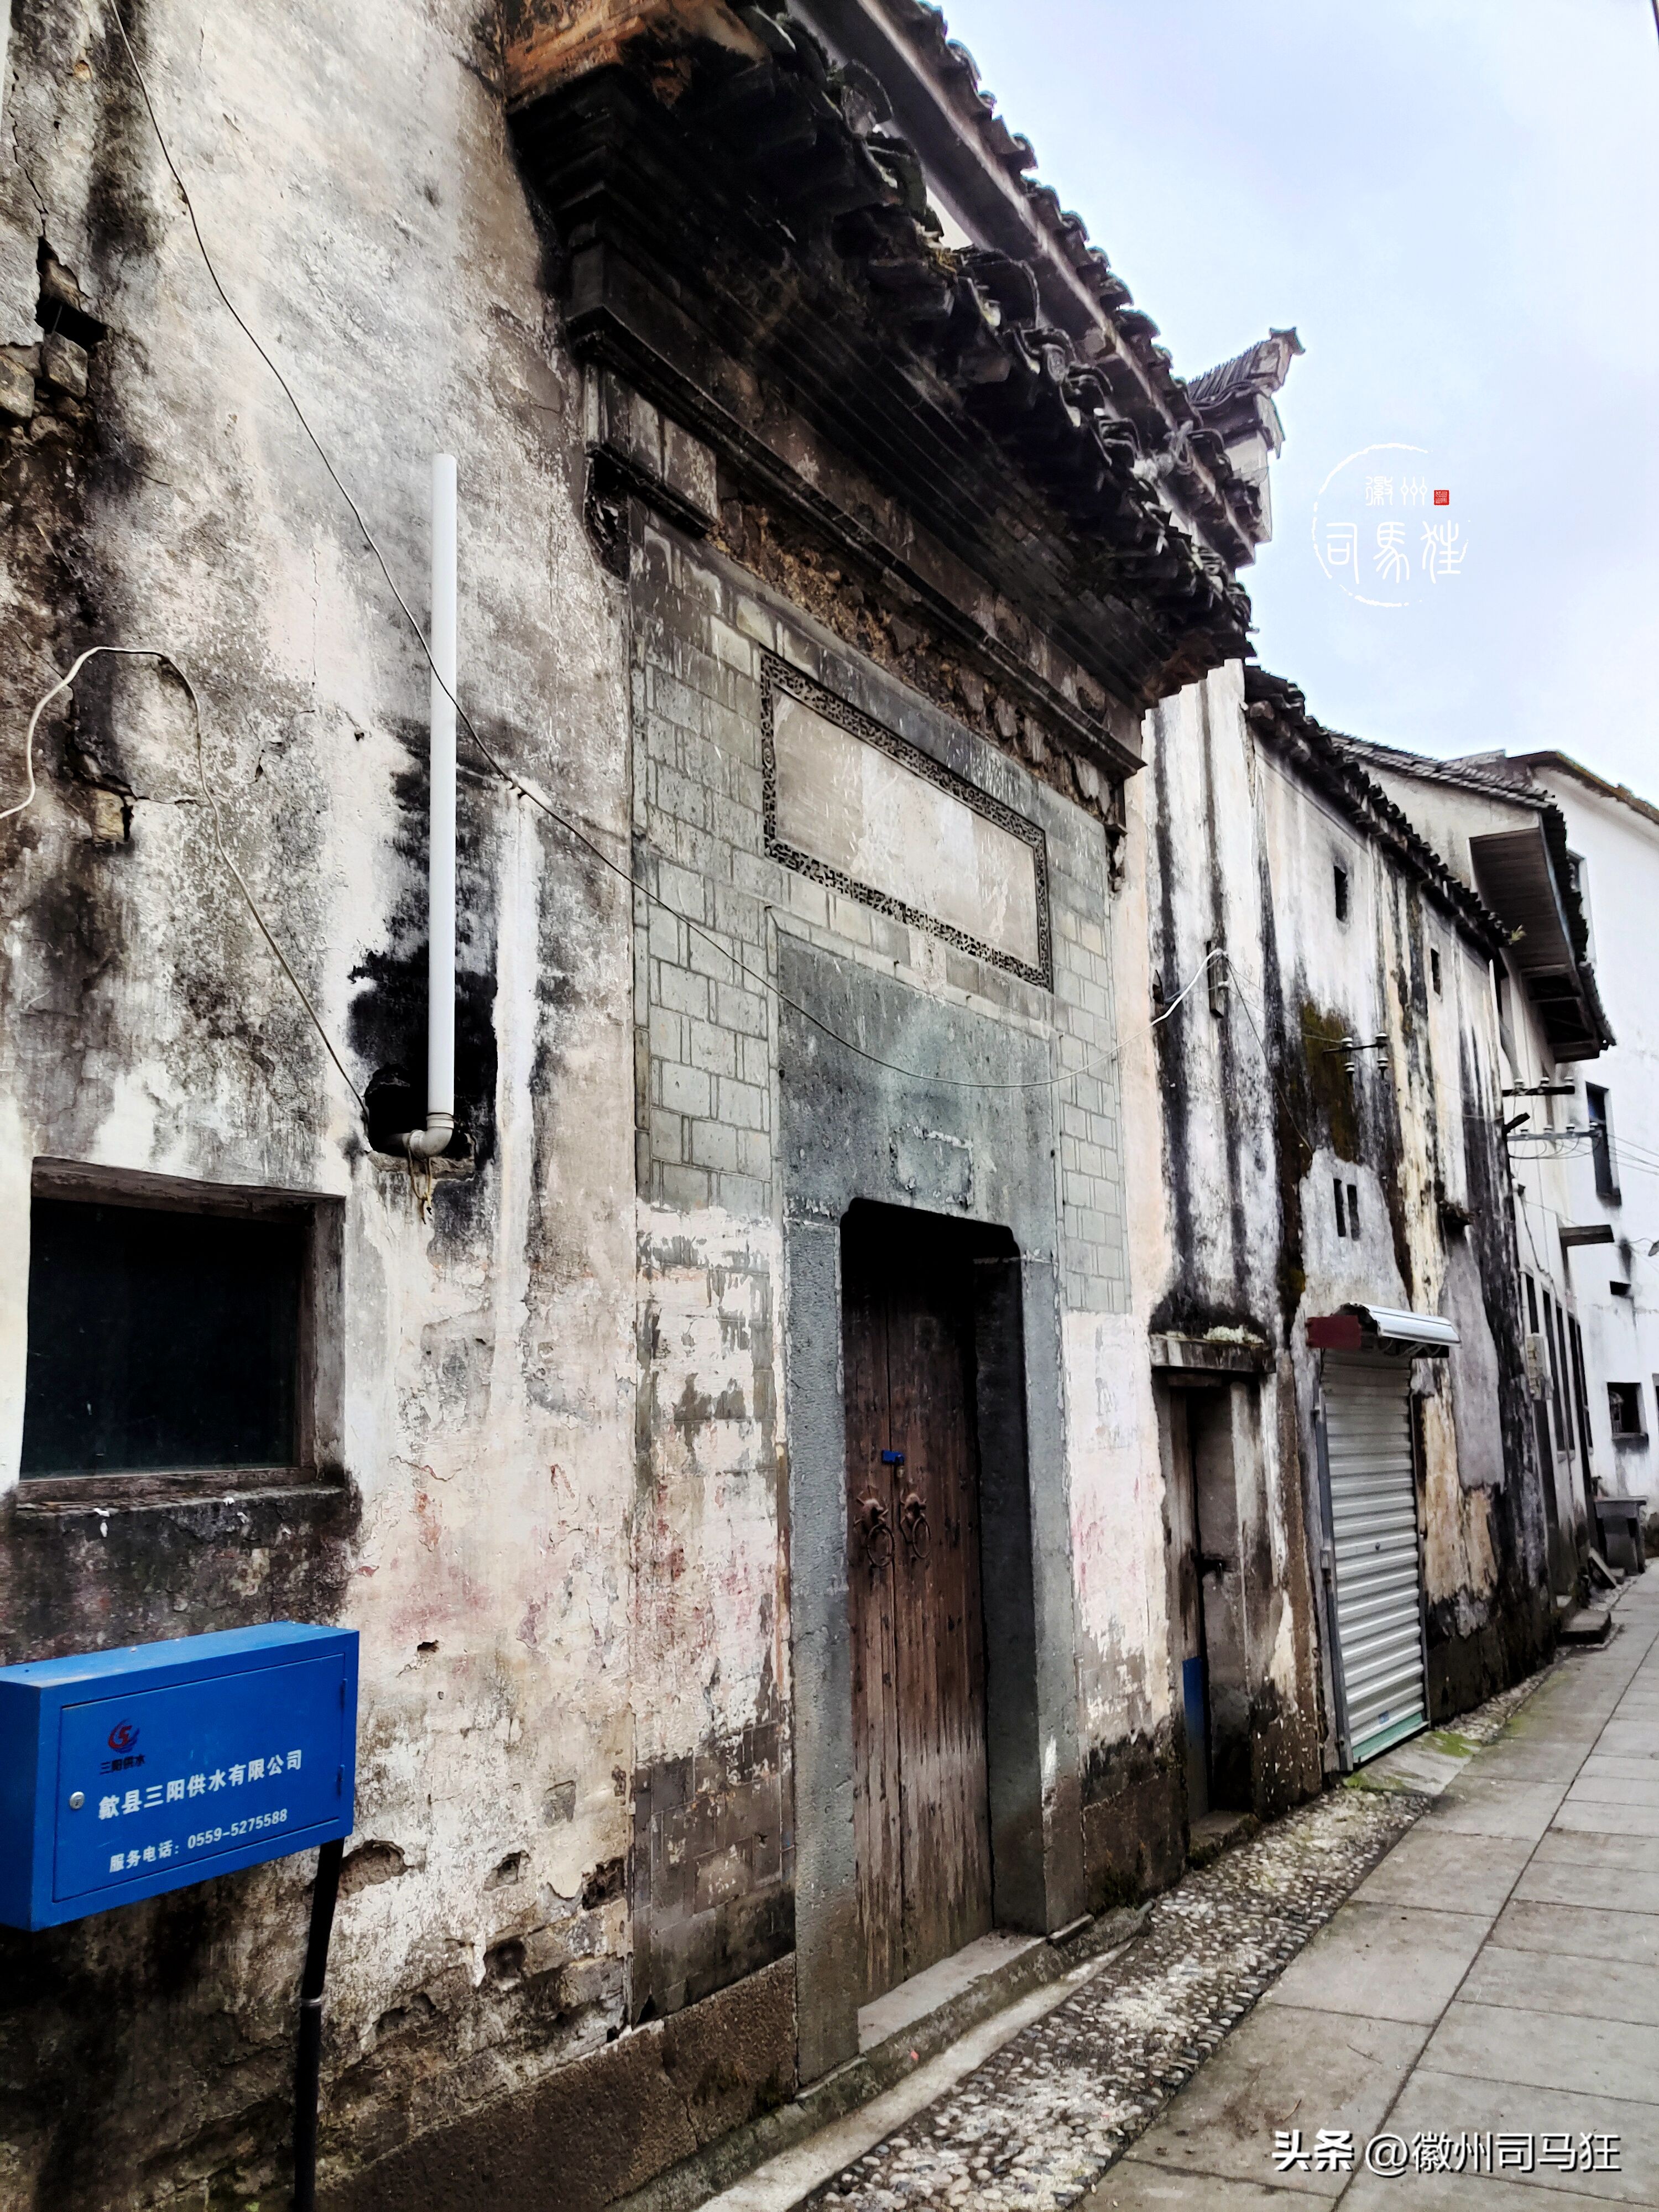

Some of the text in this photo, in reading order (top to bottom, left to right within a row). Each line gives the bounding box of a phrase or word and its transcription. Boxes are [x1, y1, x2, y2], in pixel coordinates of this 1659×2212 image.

[98, 1749, 302, 1820] 歙县三阳供水有限公司
[100, 1754, 145, 1775] 三阳供水
[187, 1808, 288, 1849] 0559-5275588
